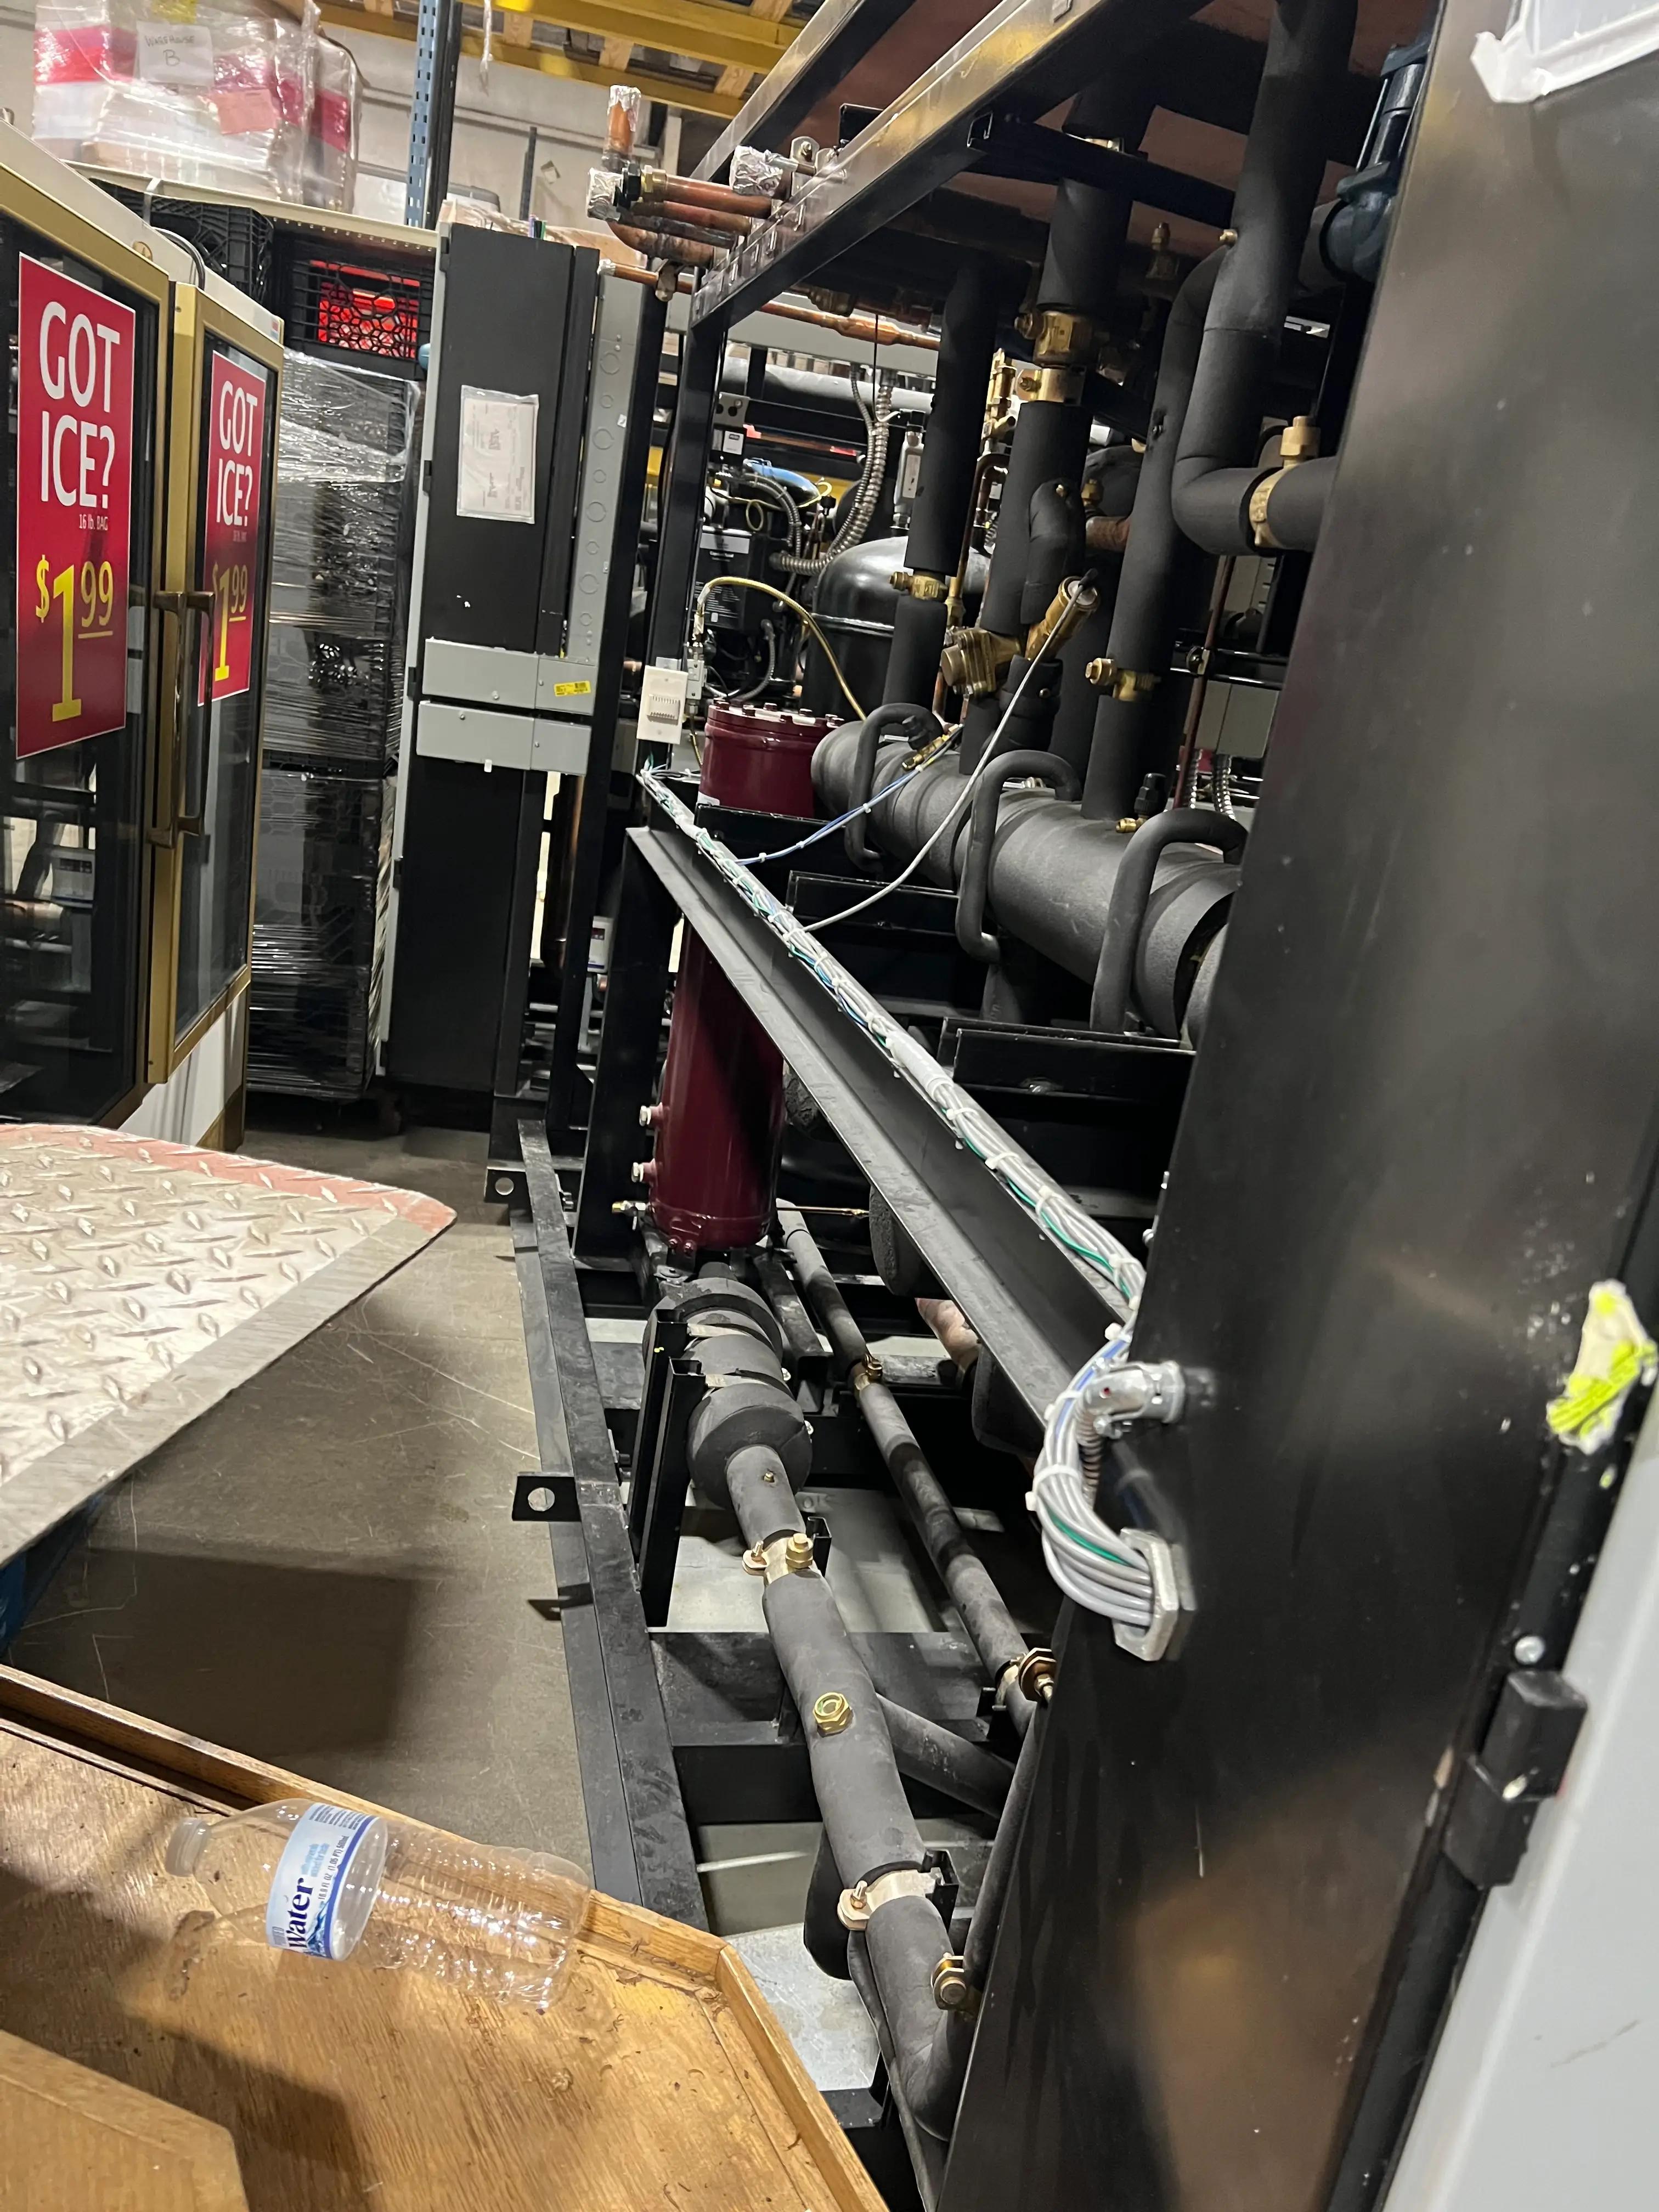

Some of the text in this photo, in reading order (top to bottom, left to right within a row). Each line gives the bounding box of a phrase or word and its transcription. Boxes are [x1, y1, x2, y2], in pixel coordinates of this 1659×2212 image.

[163, 49, 180, 66] B
[40, 301, 120, 413] GOT
[219, 380, 258, 456] GOT
[41, 411, 115, 509] ICE?
[216, 458, 253, 527] ICE?
[79, 514, 87, 529] 16
[97, 516, 108, 531] BAG
[285, 1877, 314, 1948] Water
